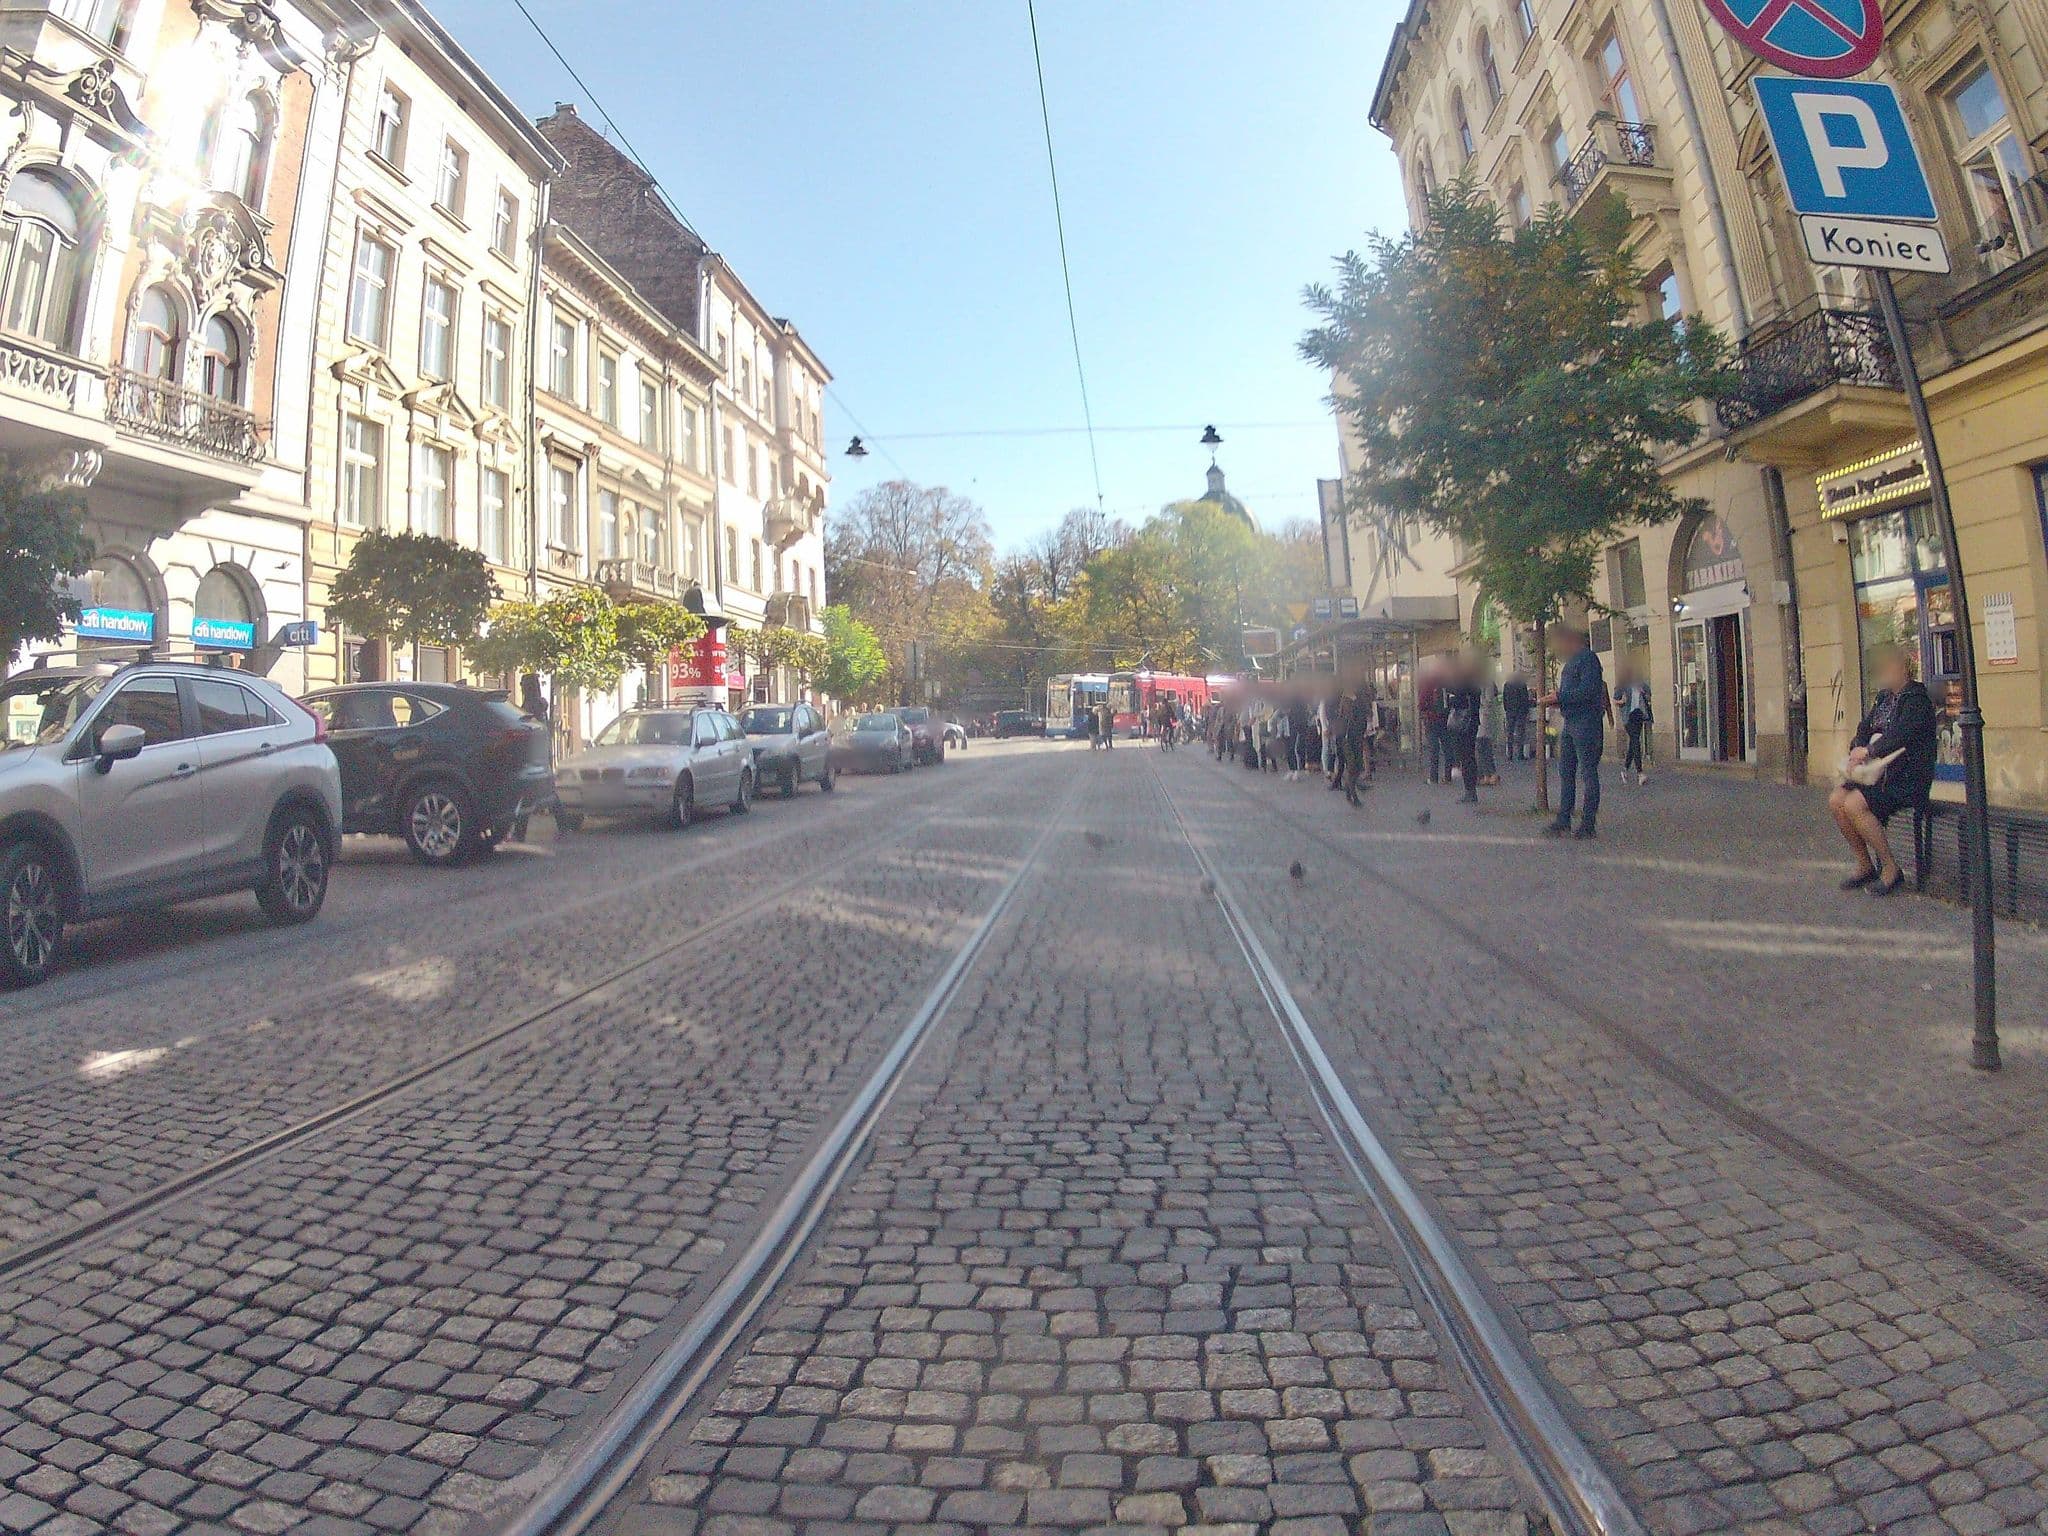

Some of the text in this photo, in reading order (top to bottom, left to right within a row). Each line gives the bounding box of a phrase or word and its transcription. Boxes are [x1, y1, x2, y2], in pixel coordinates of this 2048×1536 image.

[1792, 93, 1888, 198] P
[1821, 226, 1931, 262] Koniec
[101, 614, 148, 635] handlowy
[194, 622, 249, 642] citi handlowy
[289, 629, 309, 642] citi
[671, 663, 701, 679] 93%
